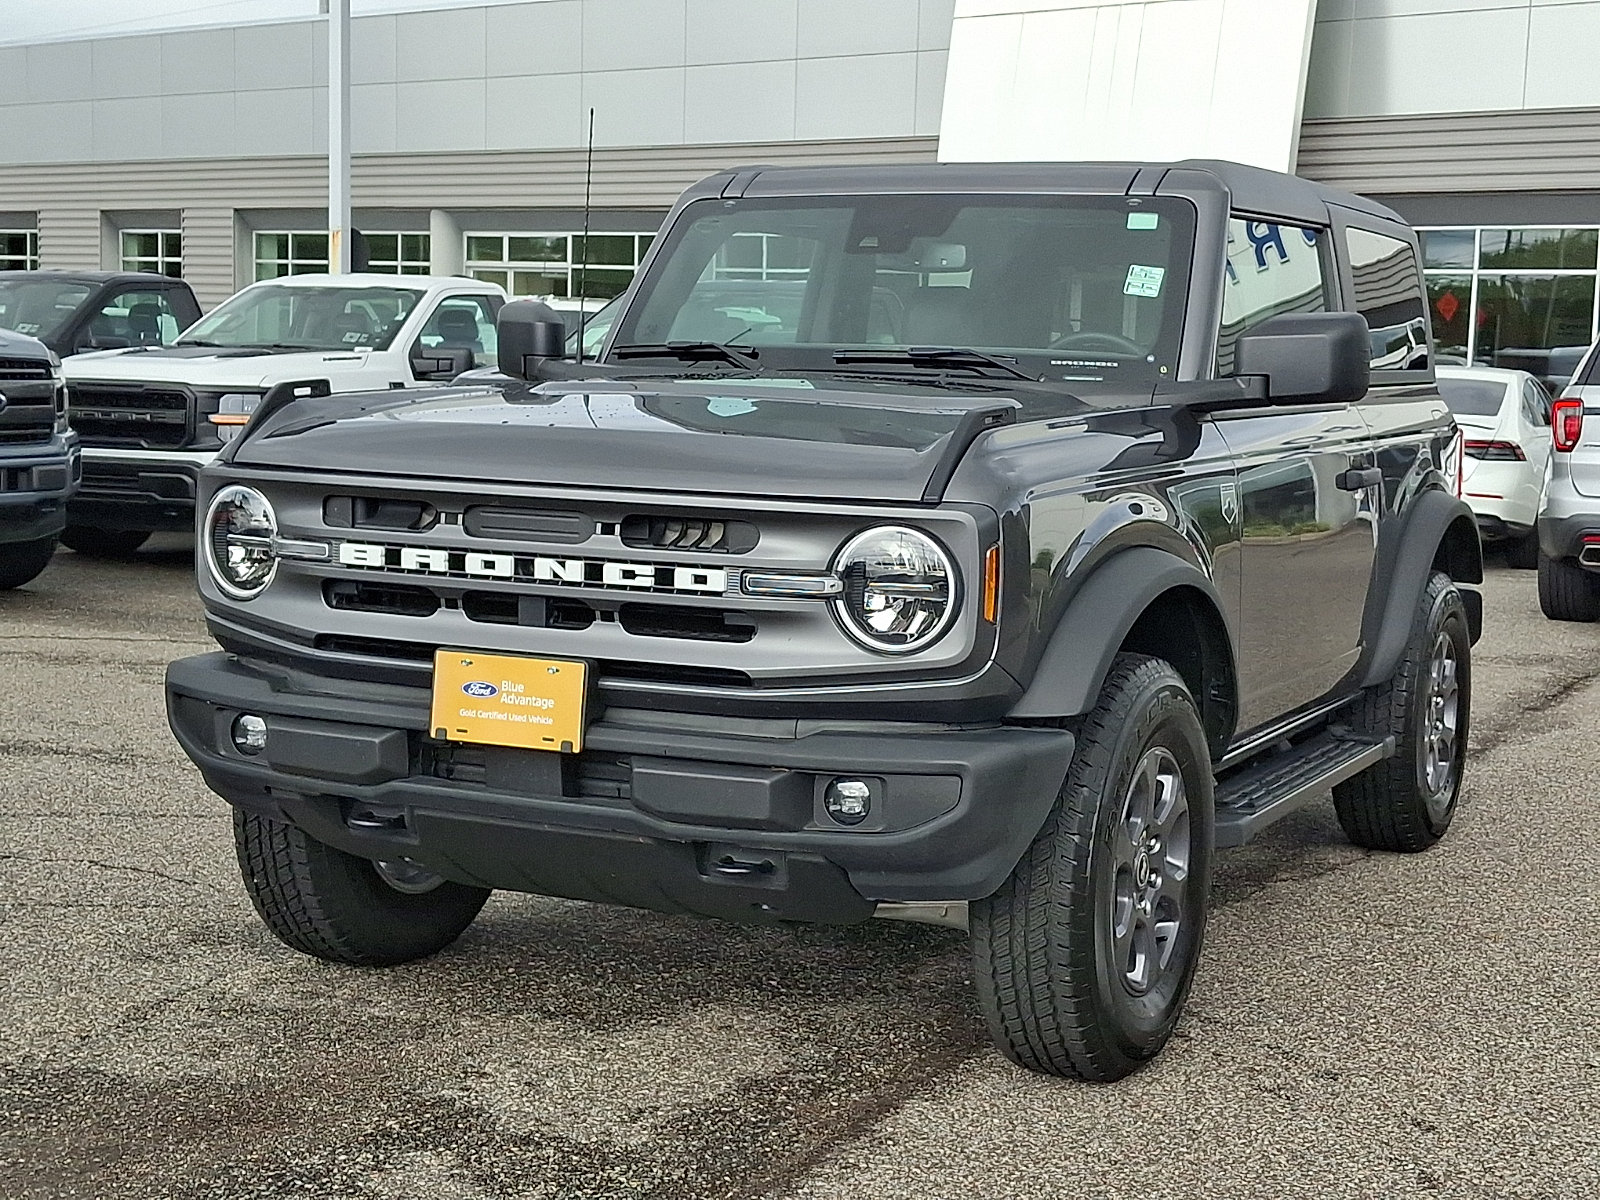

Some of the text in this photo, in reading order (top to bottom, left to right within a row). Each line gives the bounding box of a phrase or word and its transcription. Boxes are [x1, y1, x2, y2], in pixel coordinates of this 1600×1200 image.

[339, 542, 728, 591] BRONCO
[468, 682, 491, 695] Ford
[501, 680, 524, 693] Blue
[500, 693, 554, 709] Advantage
[459, 708, 553, 724] Gold Certified Used Vehicle
